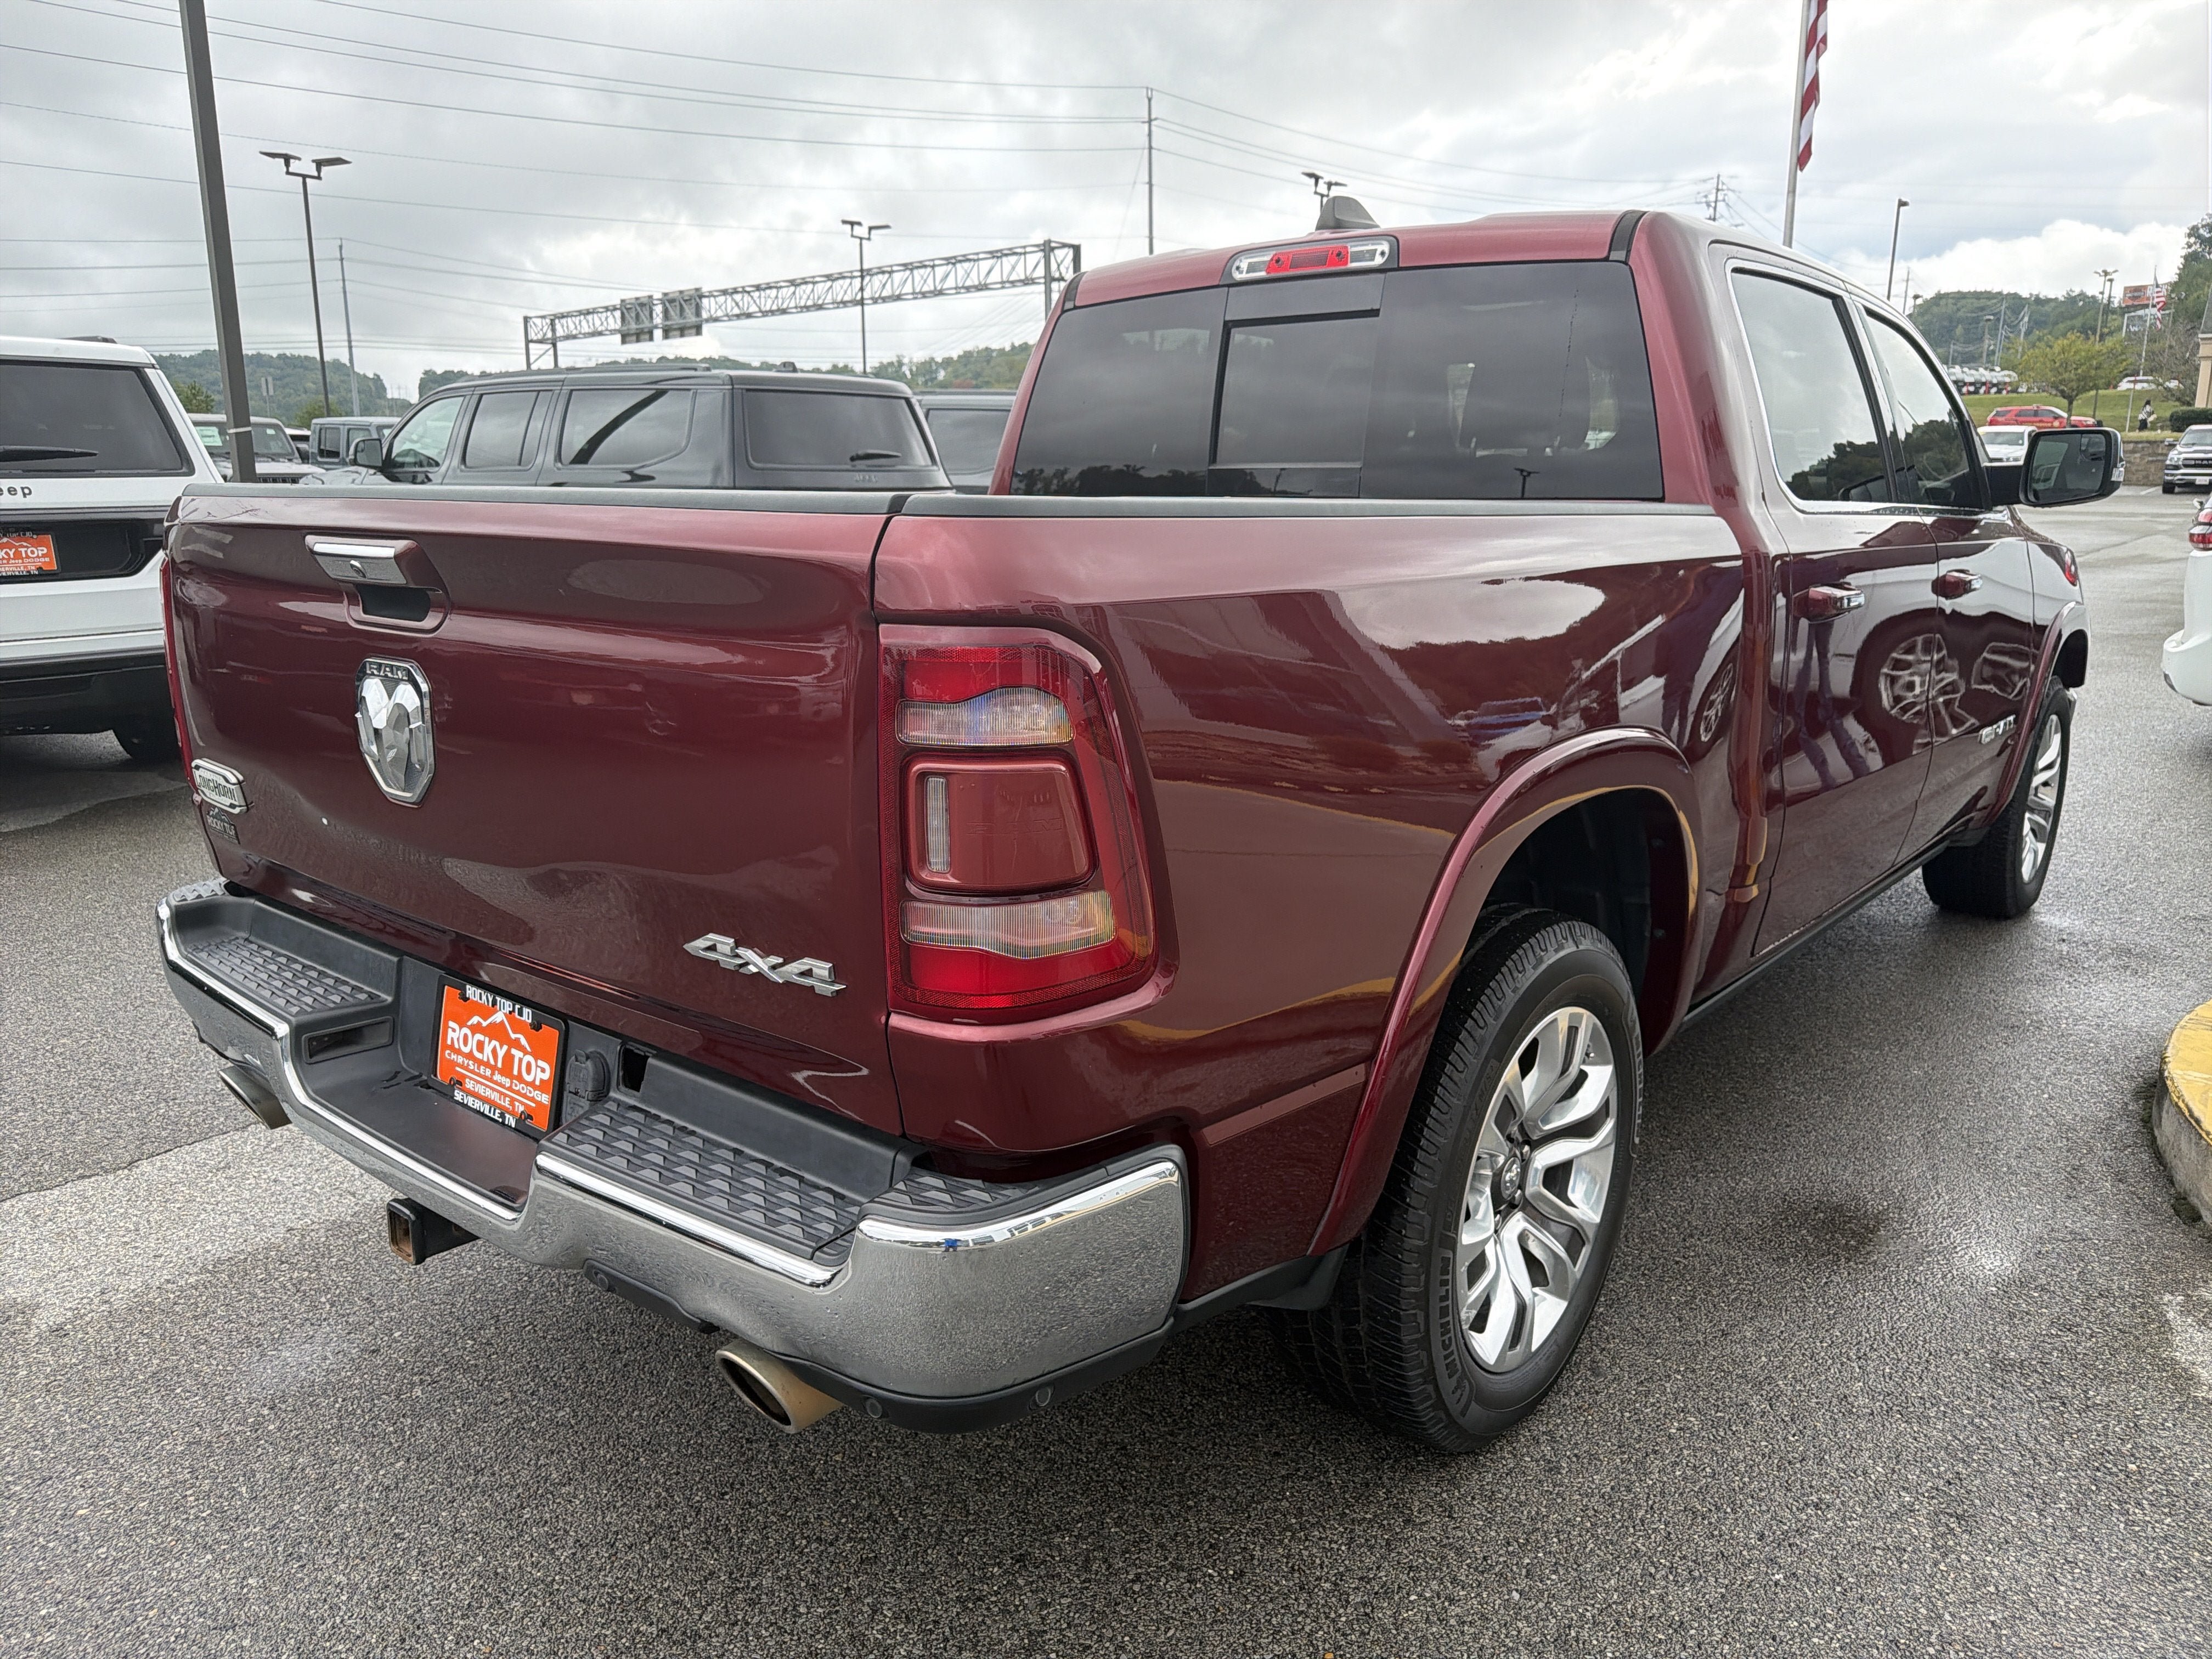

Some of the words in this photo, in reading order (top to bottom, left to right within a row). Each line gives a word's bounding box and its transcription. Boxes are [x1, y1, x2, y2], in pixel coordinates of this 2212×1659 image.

[18, 547, 48, 558] TOP
[366, 661, 409, 680] RAM
[194, 770, 237, 802] LONGHORN
[466, 985, 494, 1008] ROCKY
[495, 996, 513, 1015] TOP
[515, 1004, 532, 1024] CJD
[447, 1020, 509, 1069] ROCKY
[511, 1047, 551, 1086] TOP
[445, 1049, 492, 1077] CHRYSLER
[493, 1070, 511, 1088] Jeep
[512, 1080, 549, 1105] DODGE
[465, 1078, 512, 1111] SEVIERVILLE,
[514, 1100, 524, 1114] TN
[454, 1090, 503, 1123] SEVIERVILLE,
[504, 1110, 516, 1128] TN
[1438, 1256, 1462, 1380] MICHELIN
